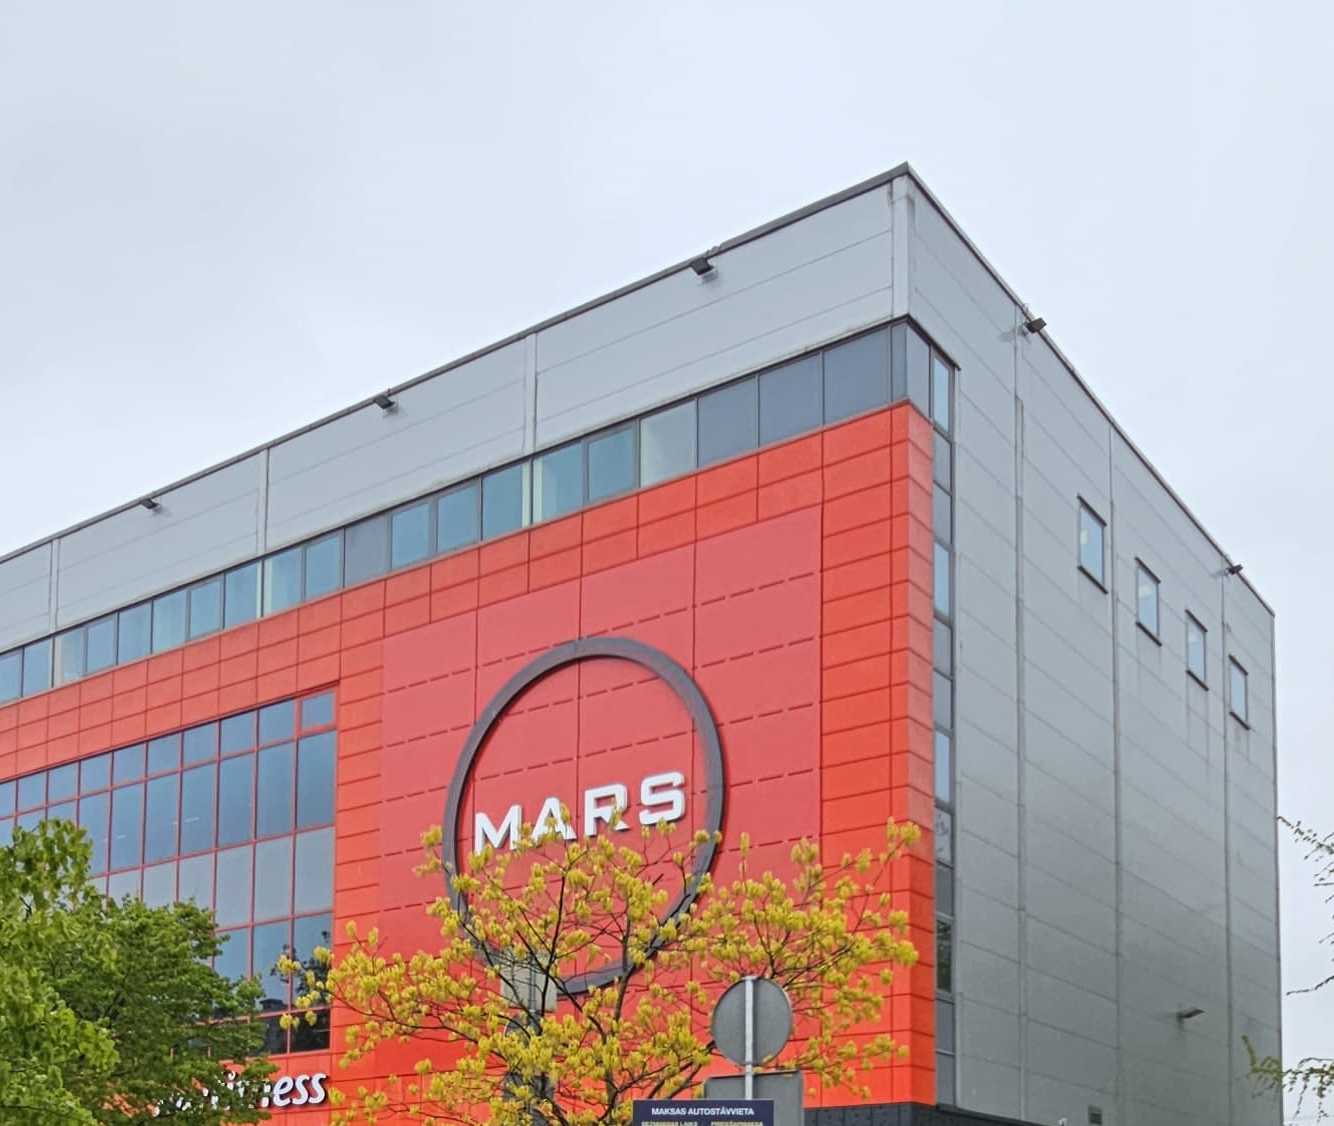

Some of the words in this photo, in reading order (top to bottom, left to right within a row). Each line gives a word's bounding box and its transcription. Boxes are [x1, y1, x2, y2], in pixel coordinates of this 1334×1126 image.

[474, 771, 685, 857] MARS
[651, 1107, 686, 1116] MAKSAS
[687, 1106, 755, 1116] AUTOSTĀVVIETA
